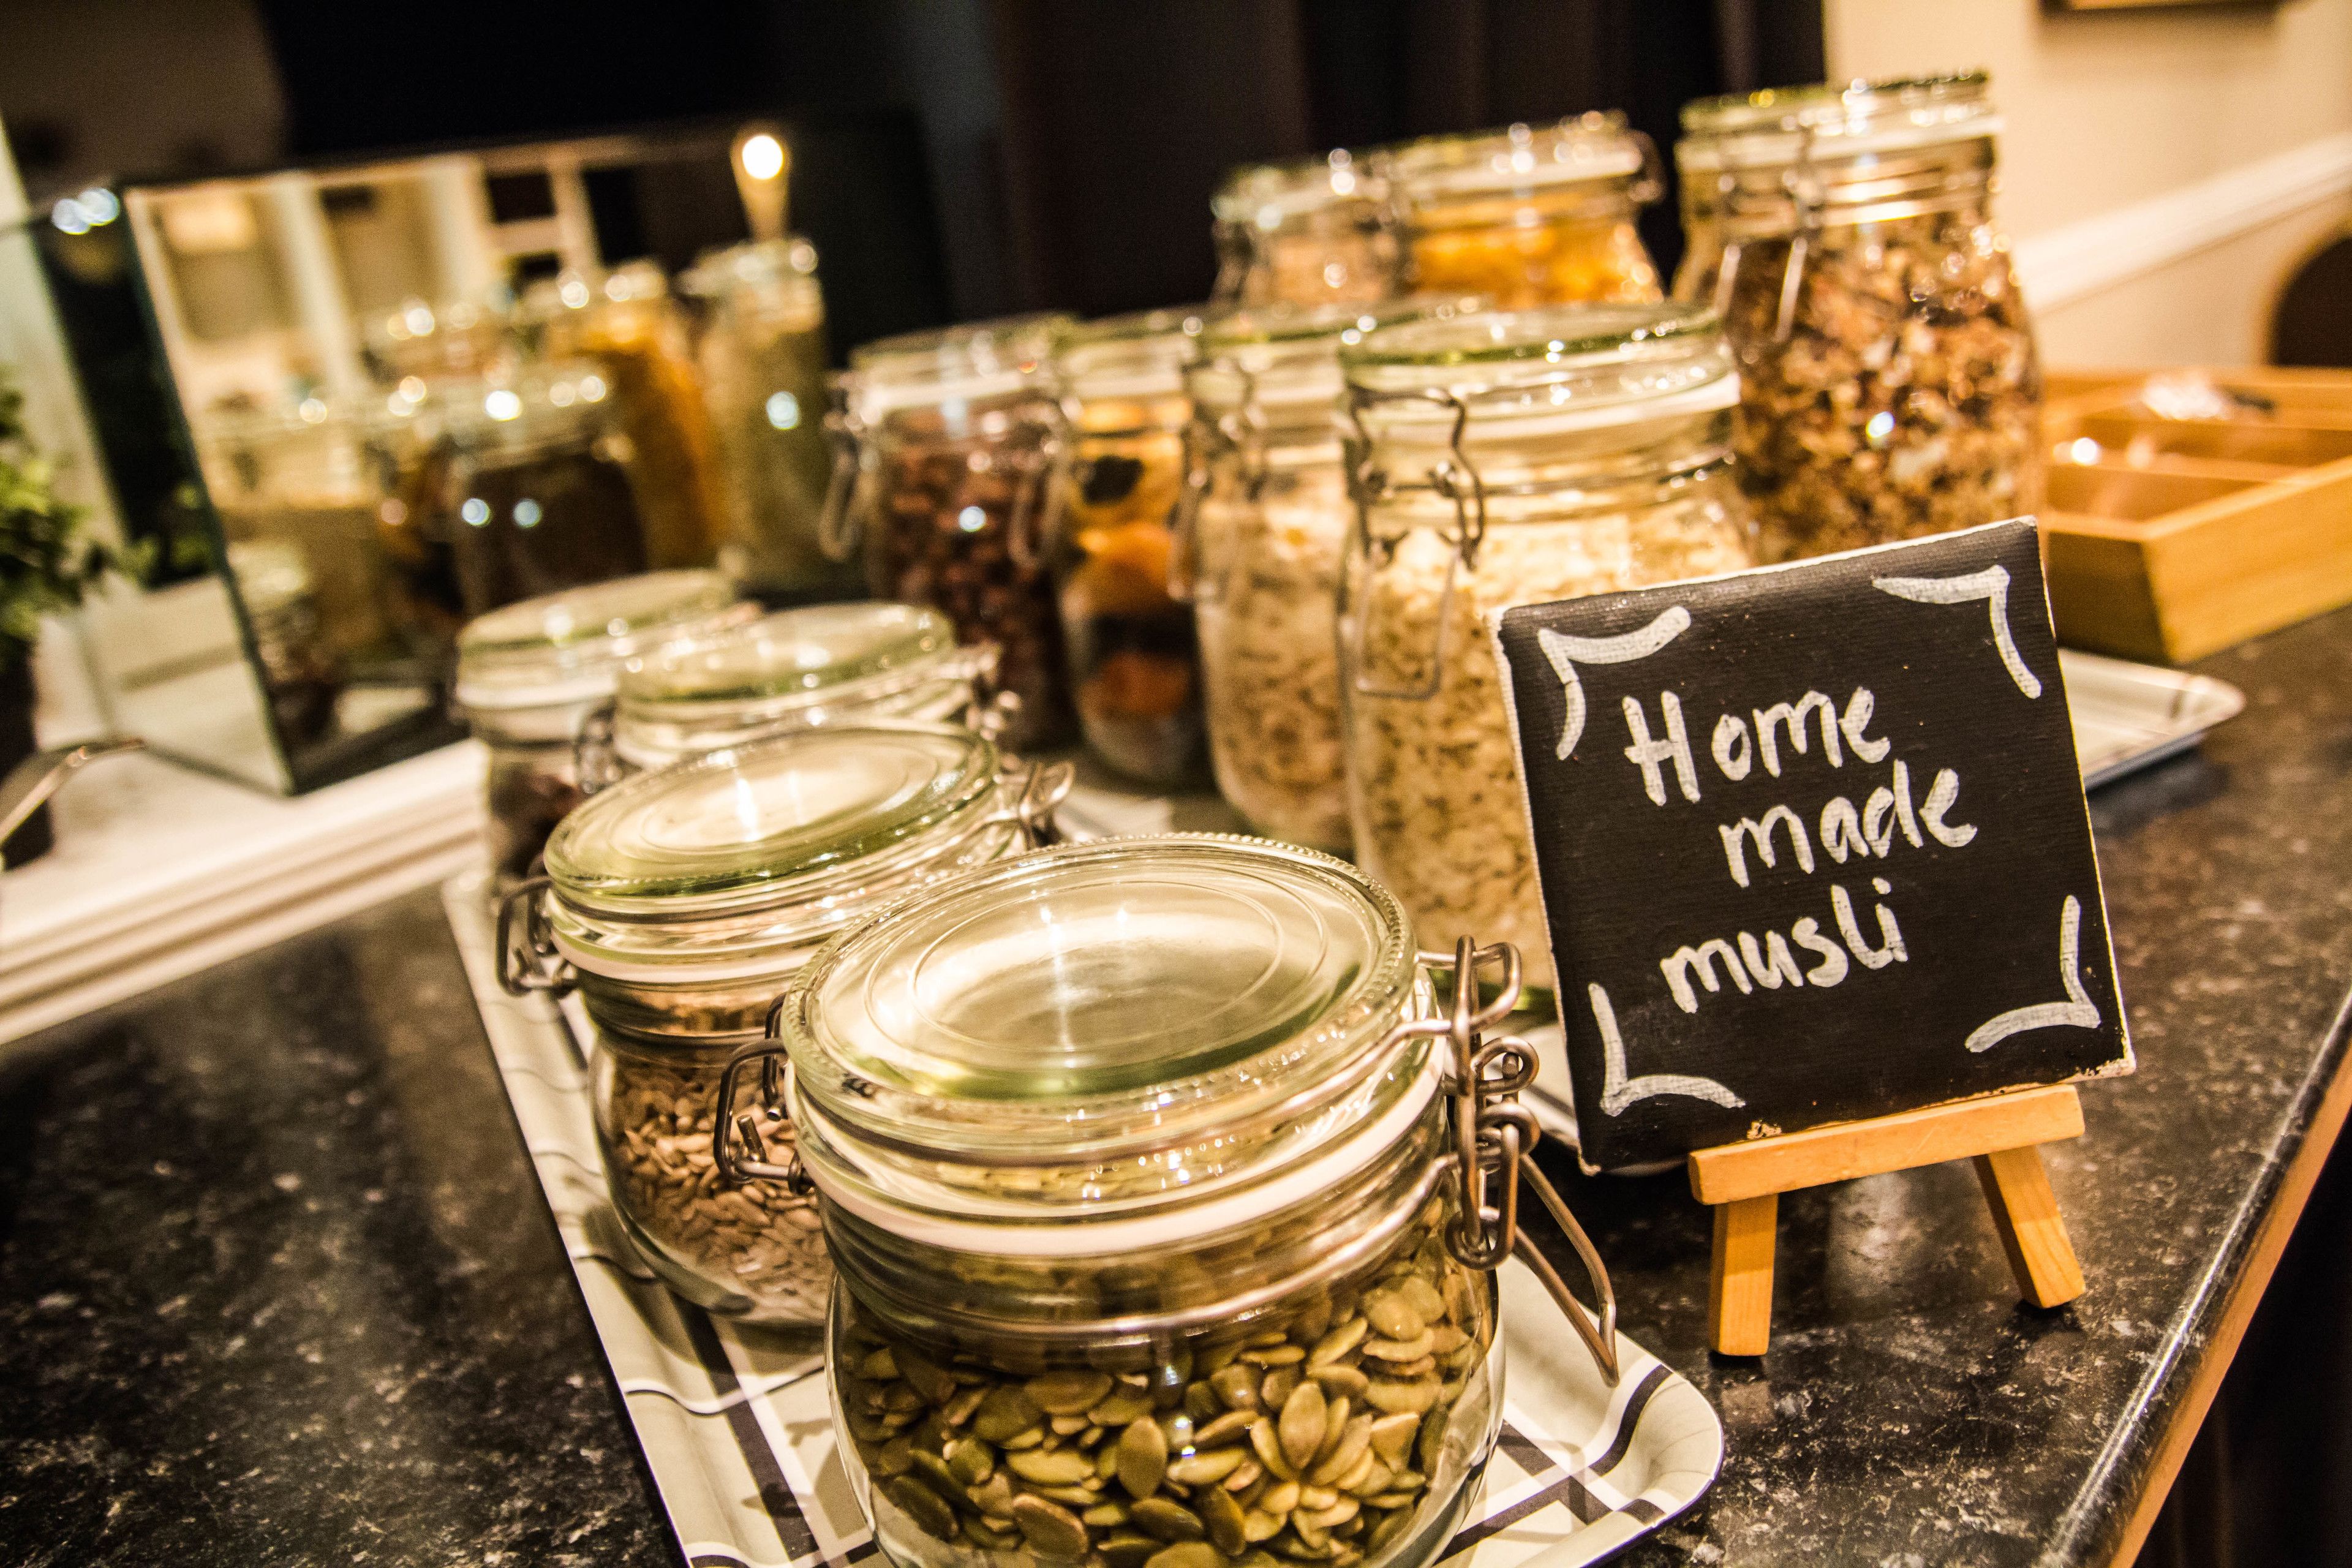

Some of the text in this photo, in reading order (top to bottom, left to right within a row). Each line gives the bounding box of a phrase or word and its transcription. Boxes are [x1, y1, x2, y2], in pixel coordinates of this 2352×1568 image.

[1622, 686, 1891, 807] Home
[1719, 759, 1978, 888] made
[1660, 877, 1908, 1014] musli
